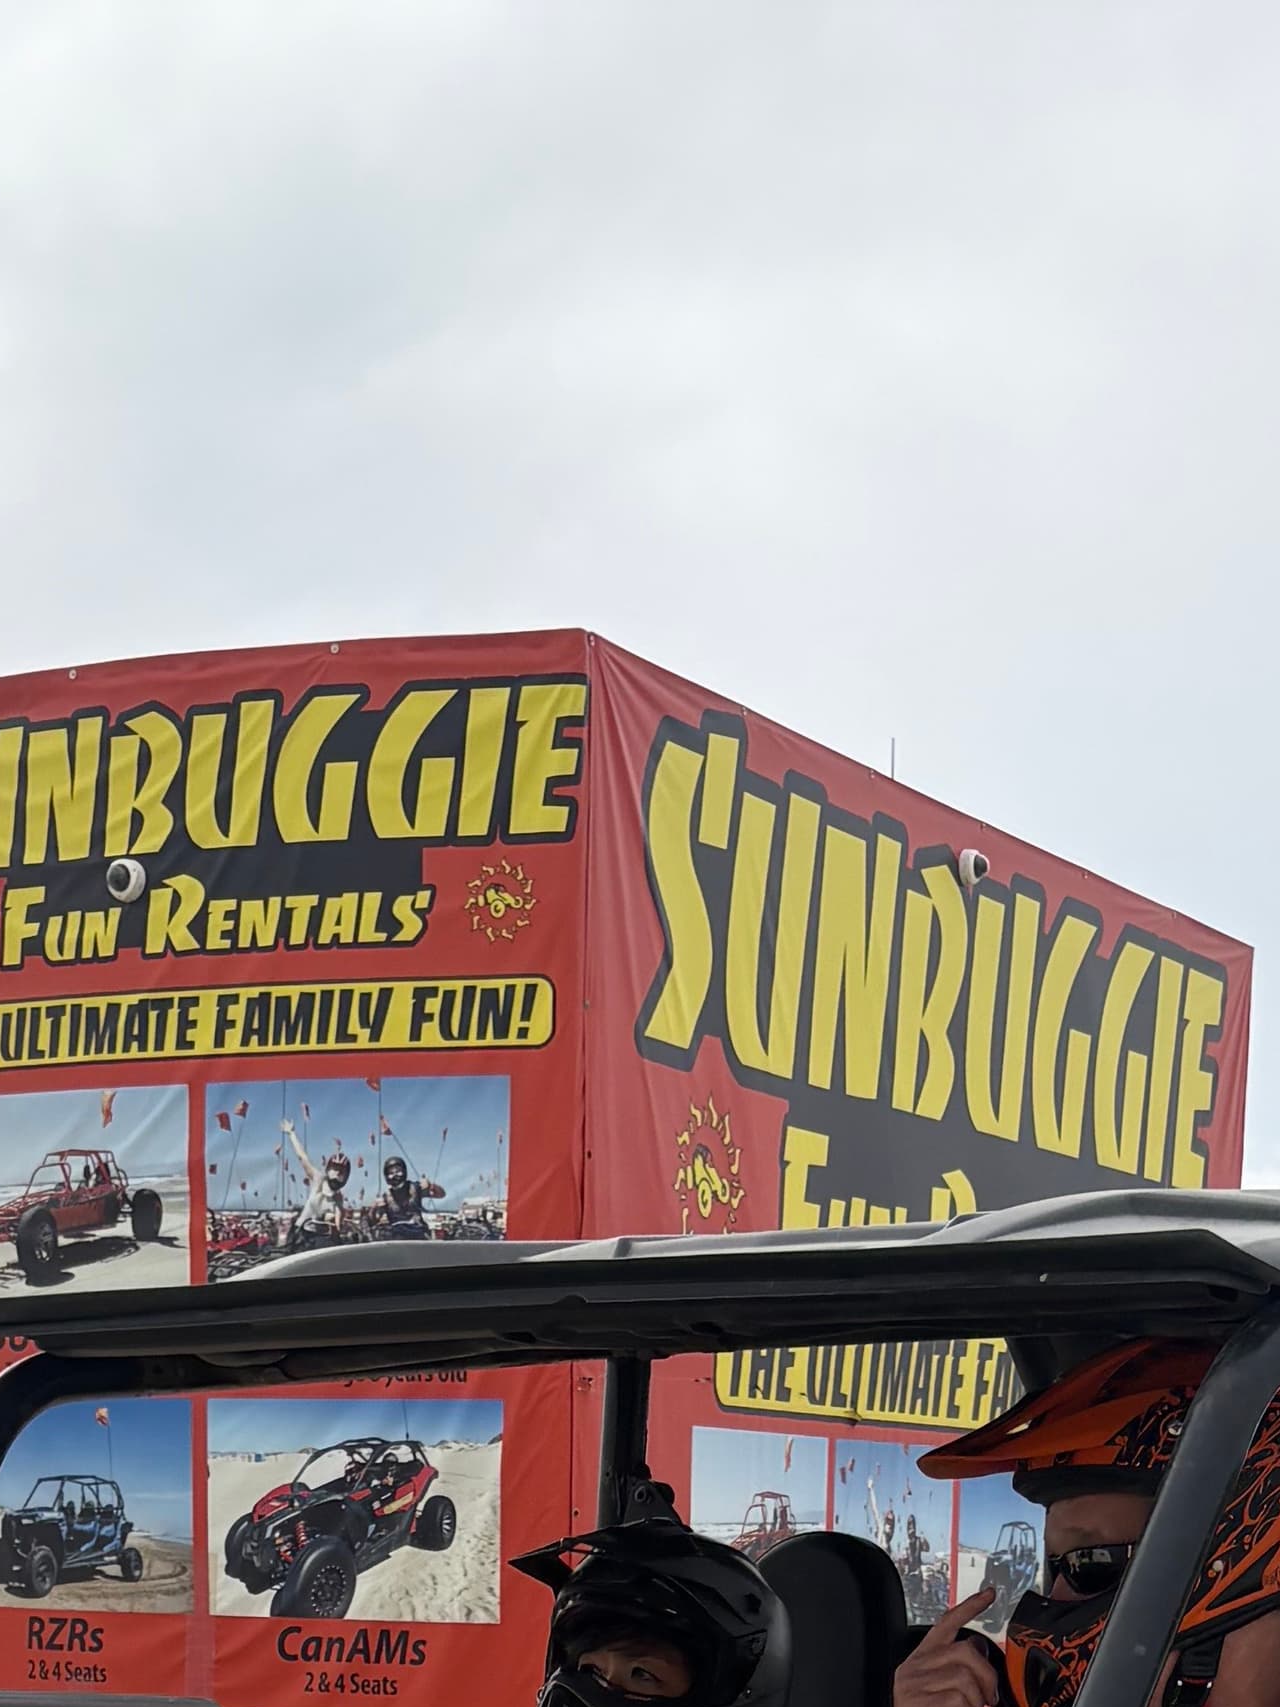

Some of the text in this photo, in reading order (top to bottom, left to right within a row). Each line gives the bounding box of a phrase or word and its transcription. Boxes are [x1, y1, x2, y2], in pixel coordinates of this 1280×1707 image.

[144, 874, 432, 954] RENTALS
[644, 732, 1224, 1189] SUNBUGGIE
[0, 995, 200, 1061] ULTIMATE
[215, 988, 394, 1048] FAMILY
[409, 984, 539, 1042] FUN!
[807, 1340, 968, 1419] ULTIMATE
[27, 1616, 105, 1653] RZRs
[277, 1626, 427, 1666] CanAMs
[28, 1660, 107, 1683] 2 & 4 Seats
[304, 1672, 398, 1696] 2 & 4 Seats
